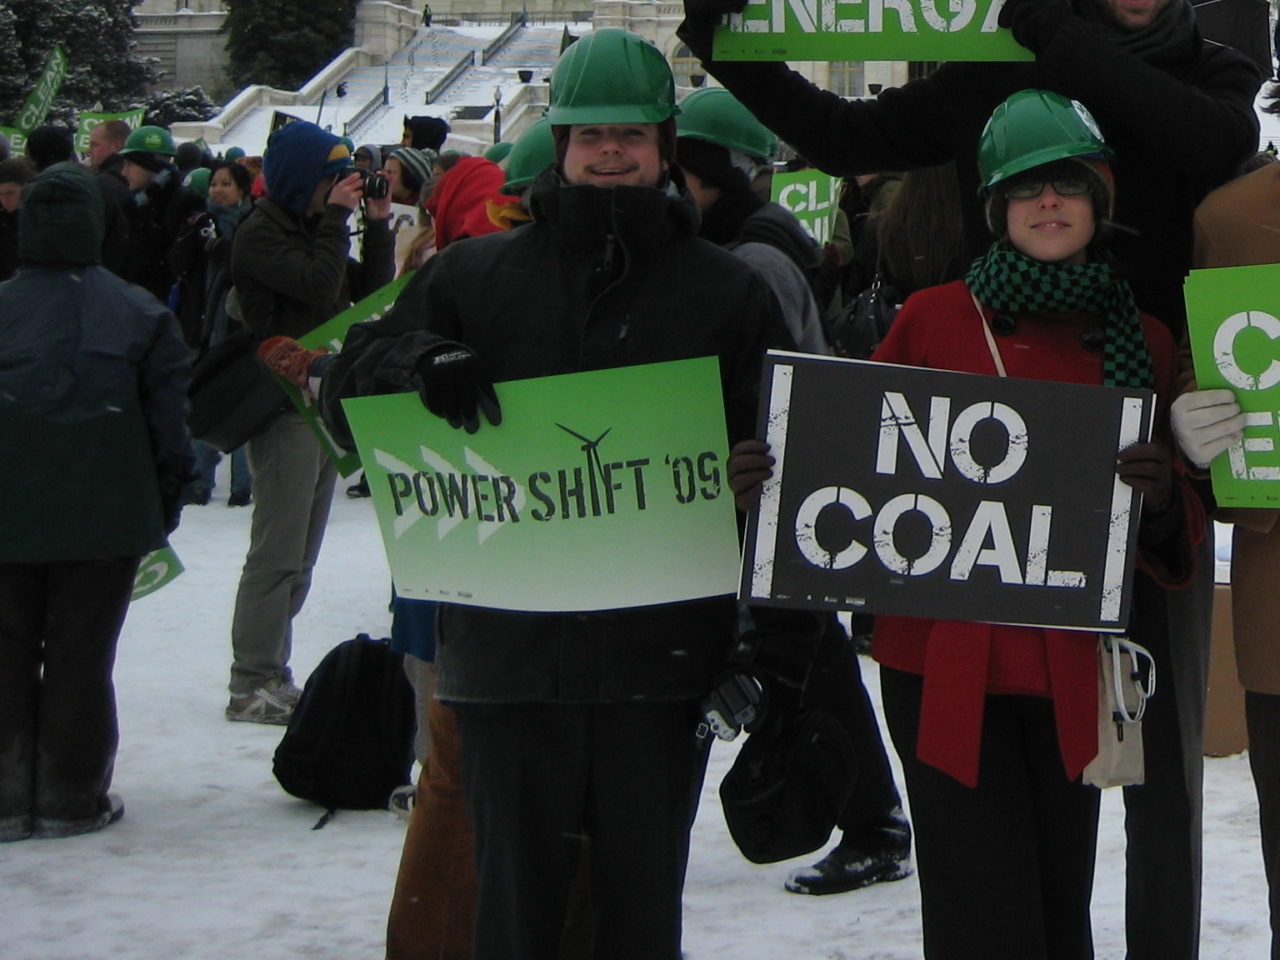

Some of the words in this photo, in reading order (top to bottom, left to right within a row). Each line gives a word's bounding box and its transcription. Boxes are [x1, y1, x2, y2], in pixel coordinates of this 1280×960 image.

[387, 469, 520, 523] POWER
[528, 440, 650, 522] SHIFT
[875, 391, 1029, 485] NO
[794, 485, 1087, 589] COAL
